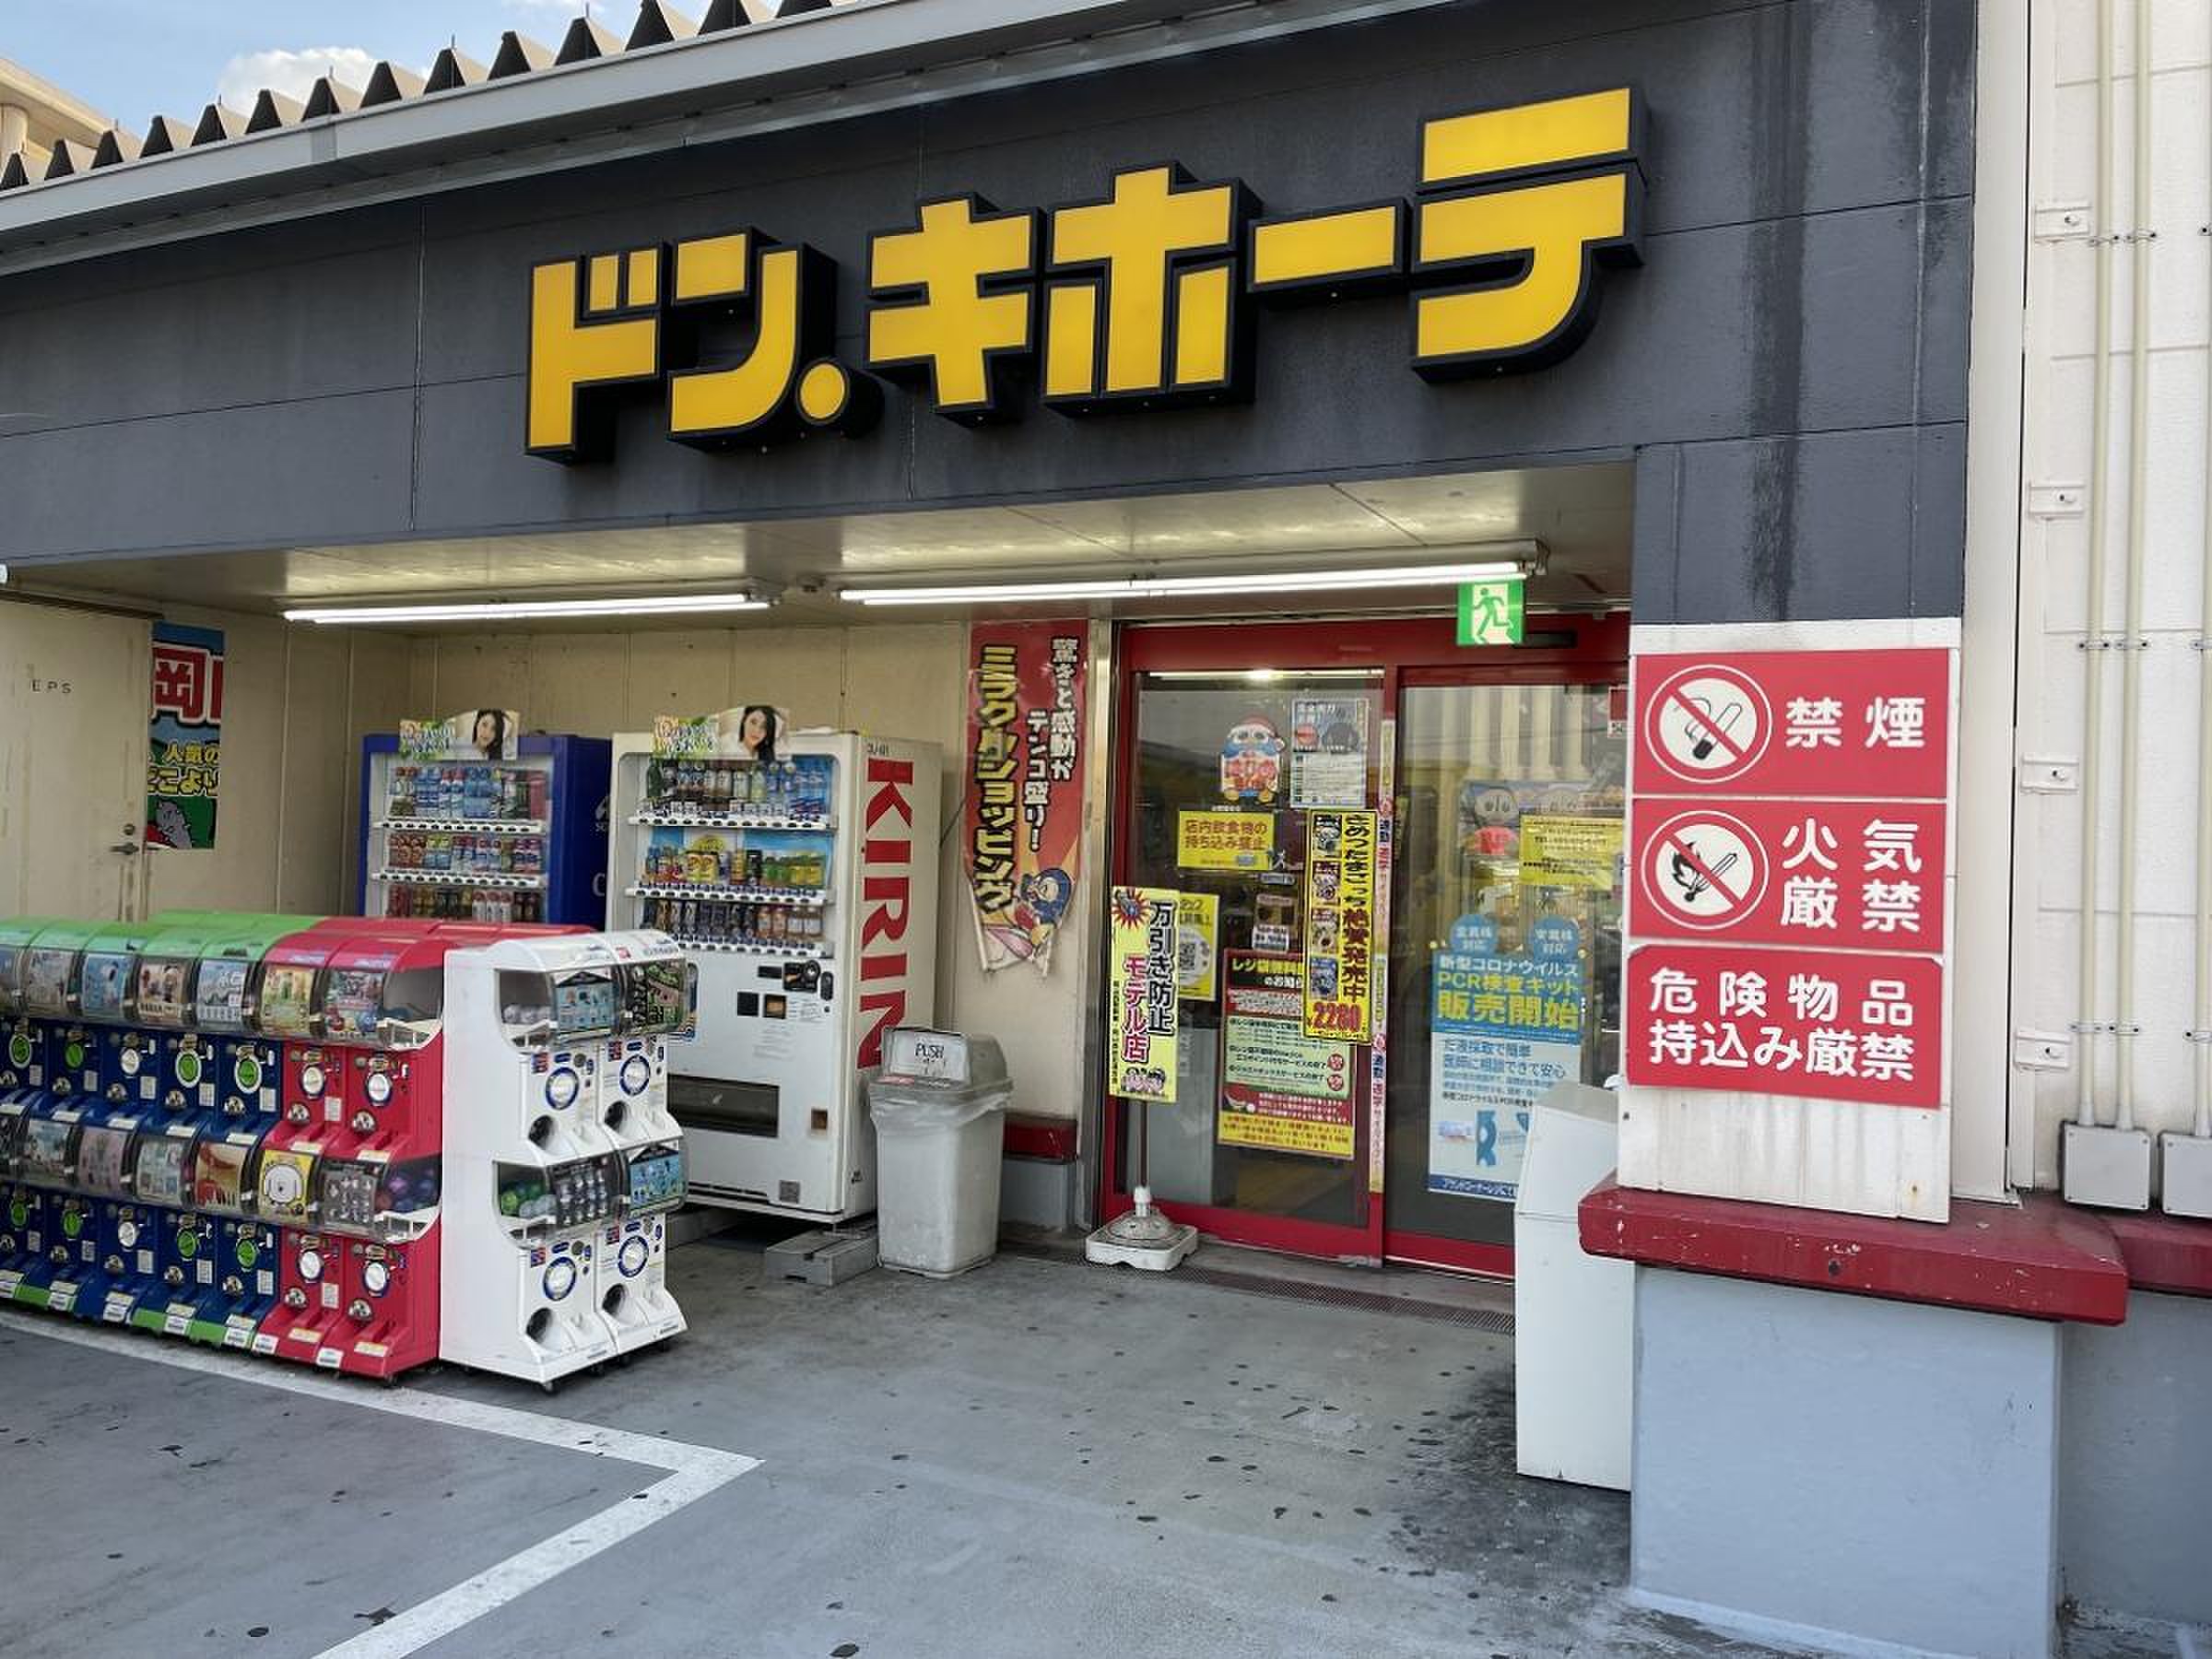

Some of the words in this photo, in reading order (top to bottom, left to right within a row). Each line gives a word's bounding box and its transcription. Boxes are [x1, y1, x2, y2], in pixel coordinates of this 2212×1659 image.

[31, 678, 73, 695] EPS
[1784, 696, 1926, 749] 禁煙
[1781, 817, 1923, 874] 火気
[857, 758, 913, 1069] KIRIN
[1780, 876, 1922, 934] 厳禁
[1147, 900, 1177, 1036] 万引き防止
[1438, 971, 1579, 996] PCR検査キット
[1439, 955, 1579, 977] 新型コロナウイルス
[1437, 990, 1579, 1031] 販売開始
[1648, 966, 1914, 1028] 危険物品
[1648, 1018, 1914, 1083] 持込み厳禁
